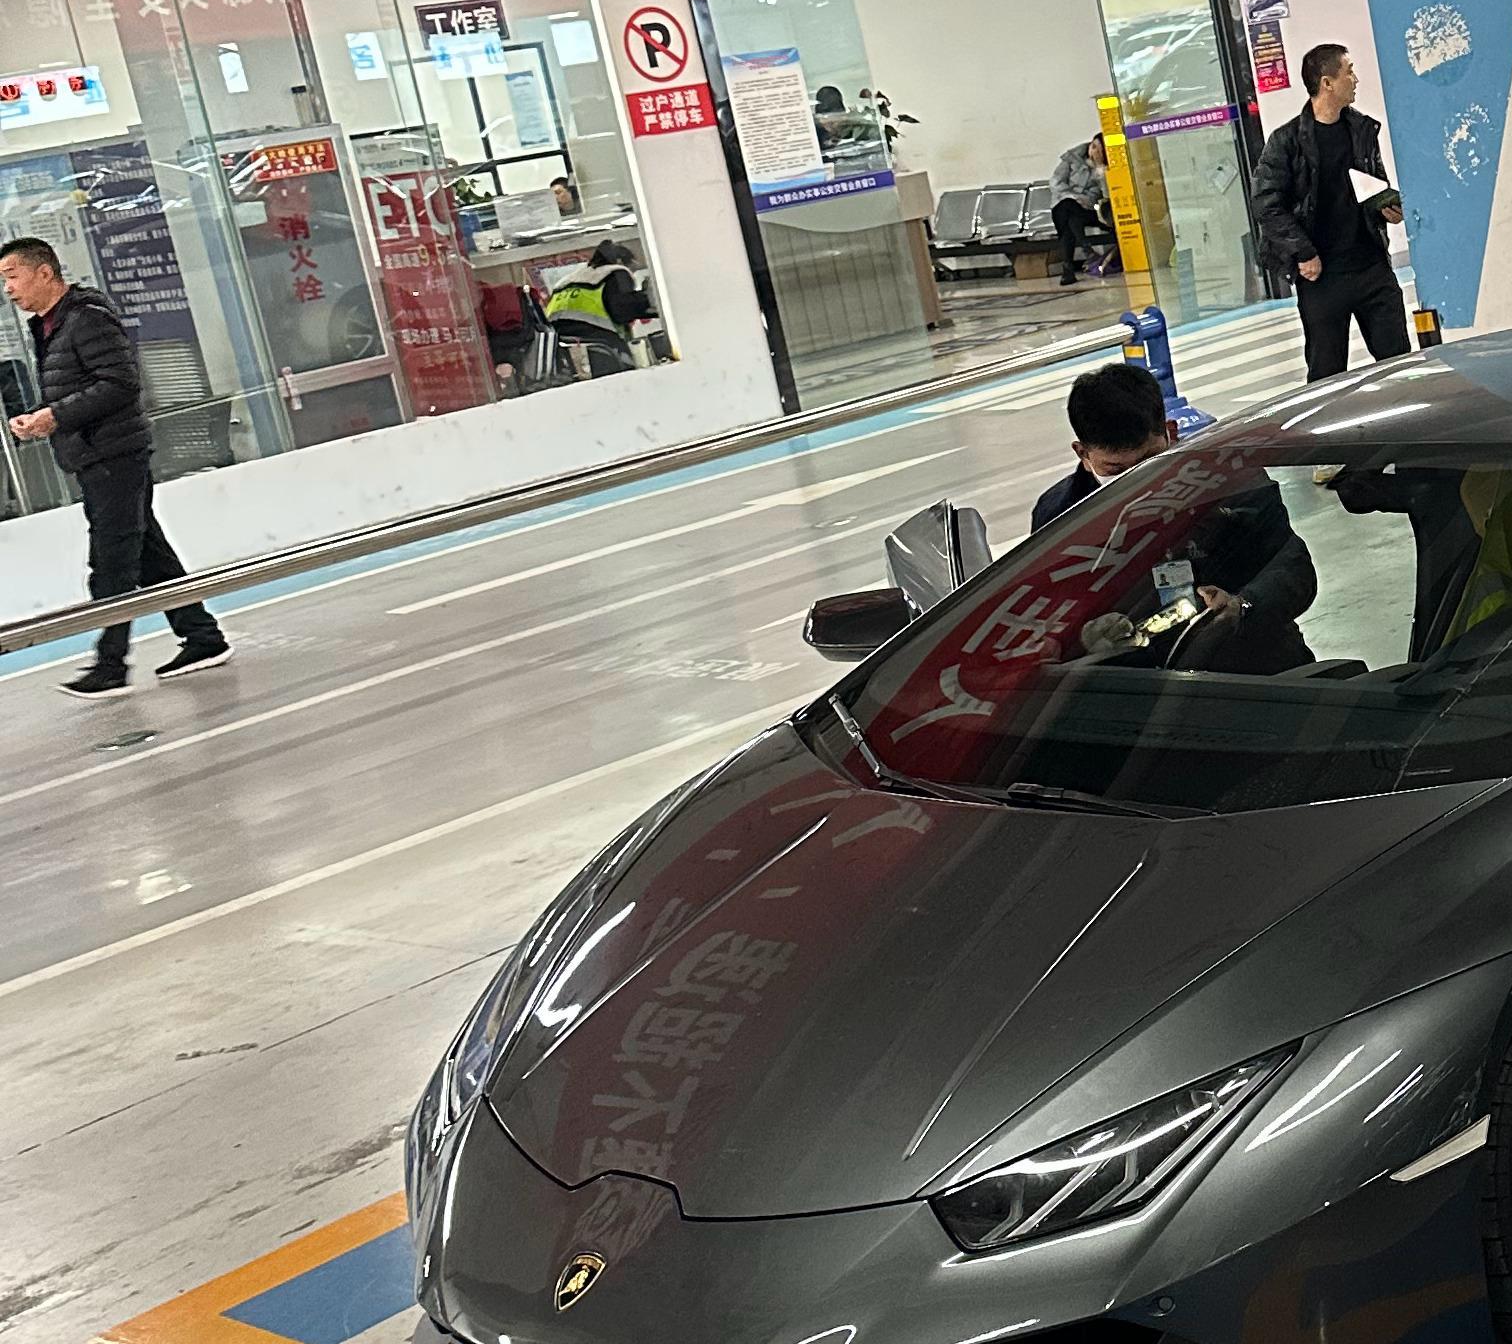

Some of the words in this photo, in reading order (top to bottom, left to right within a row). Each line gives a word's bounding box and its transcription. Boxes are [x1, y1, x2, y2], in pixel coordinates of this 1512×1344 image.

[425, 6, 498, 36] 工作室
[638, 89, 701, 113] 过户通道
[644, 108, 705, 132] 严禁停车
[279, 216, 327, 303] 消火栓
